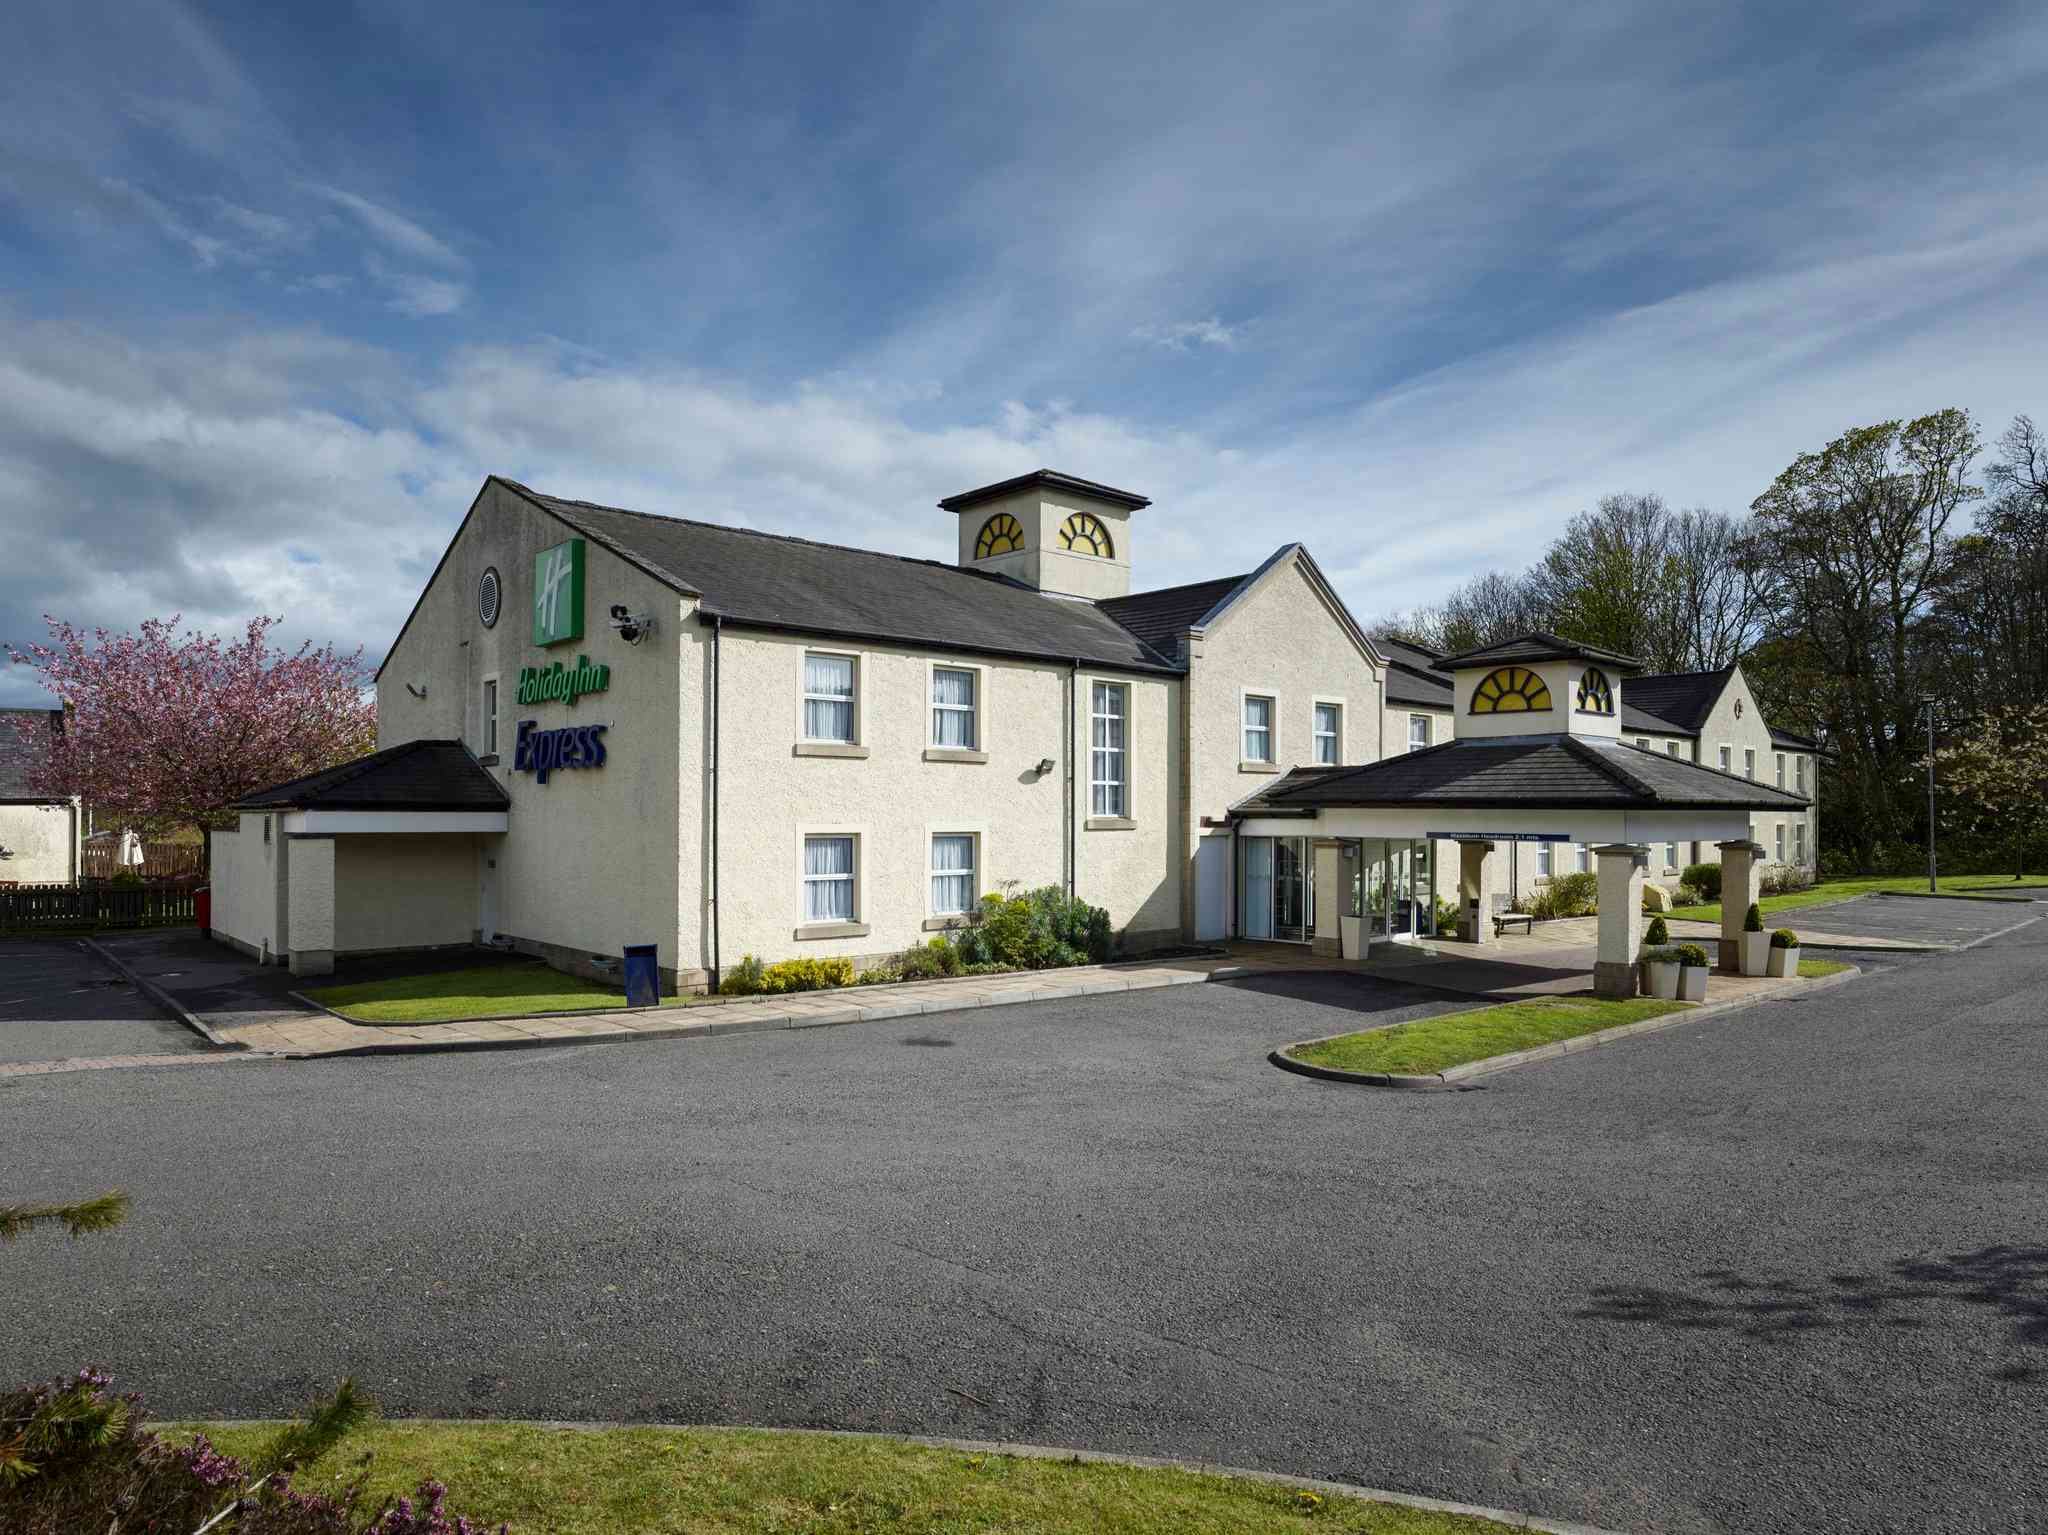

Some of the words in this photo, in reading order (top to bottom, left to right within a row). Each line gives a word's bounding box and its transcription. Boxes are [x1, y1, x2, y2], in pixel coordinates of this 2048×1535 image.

[517, 661, 576, 705] Holiday
[574, 655, 609, 695] Inn
[514, 720, 608, 785] Express
